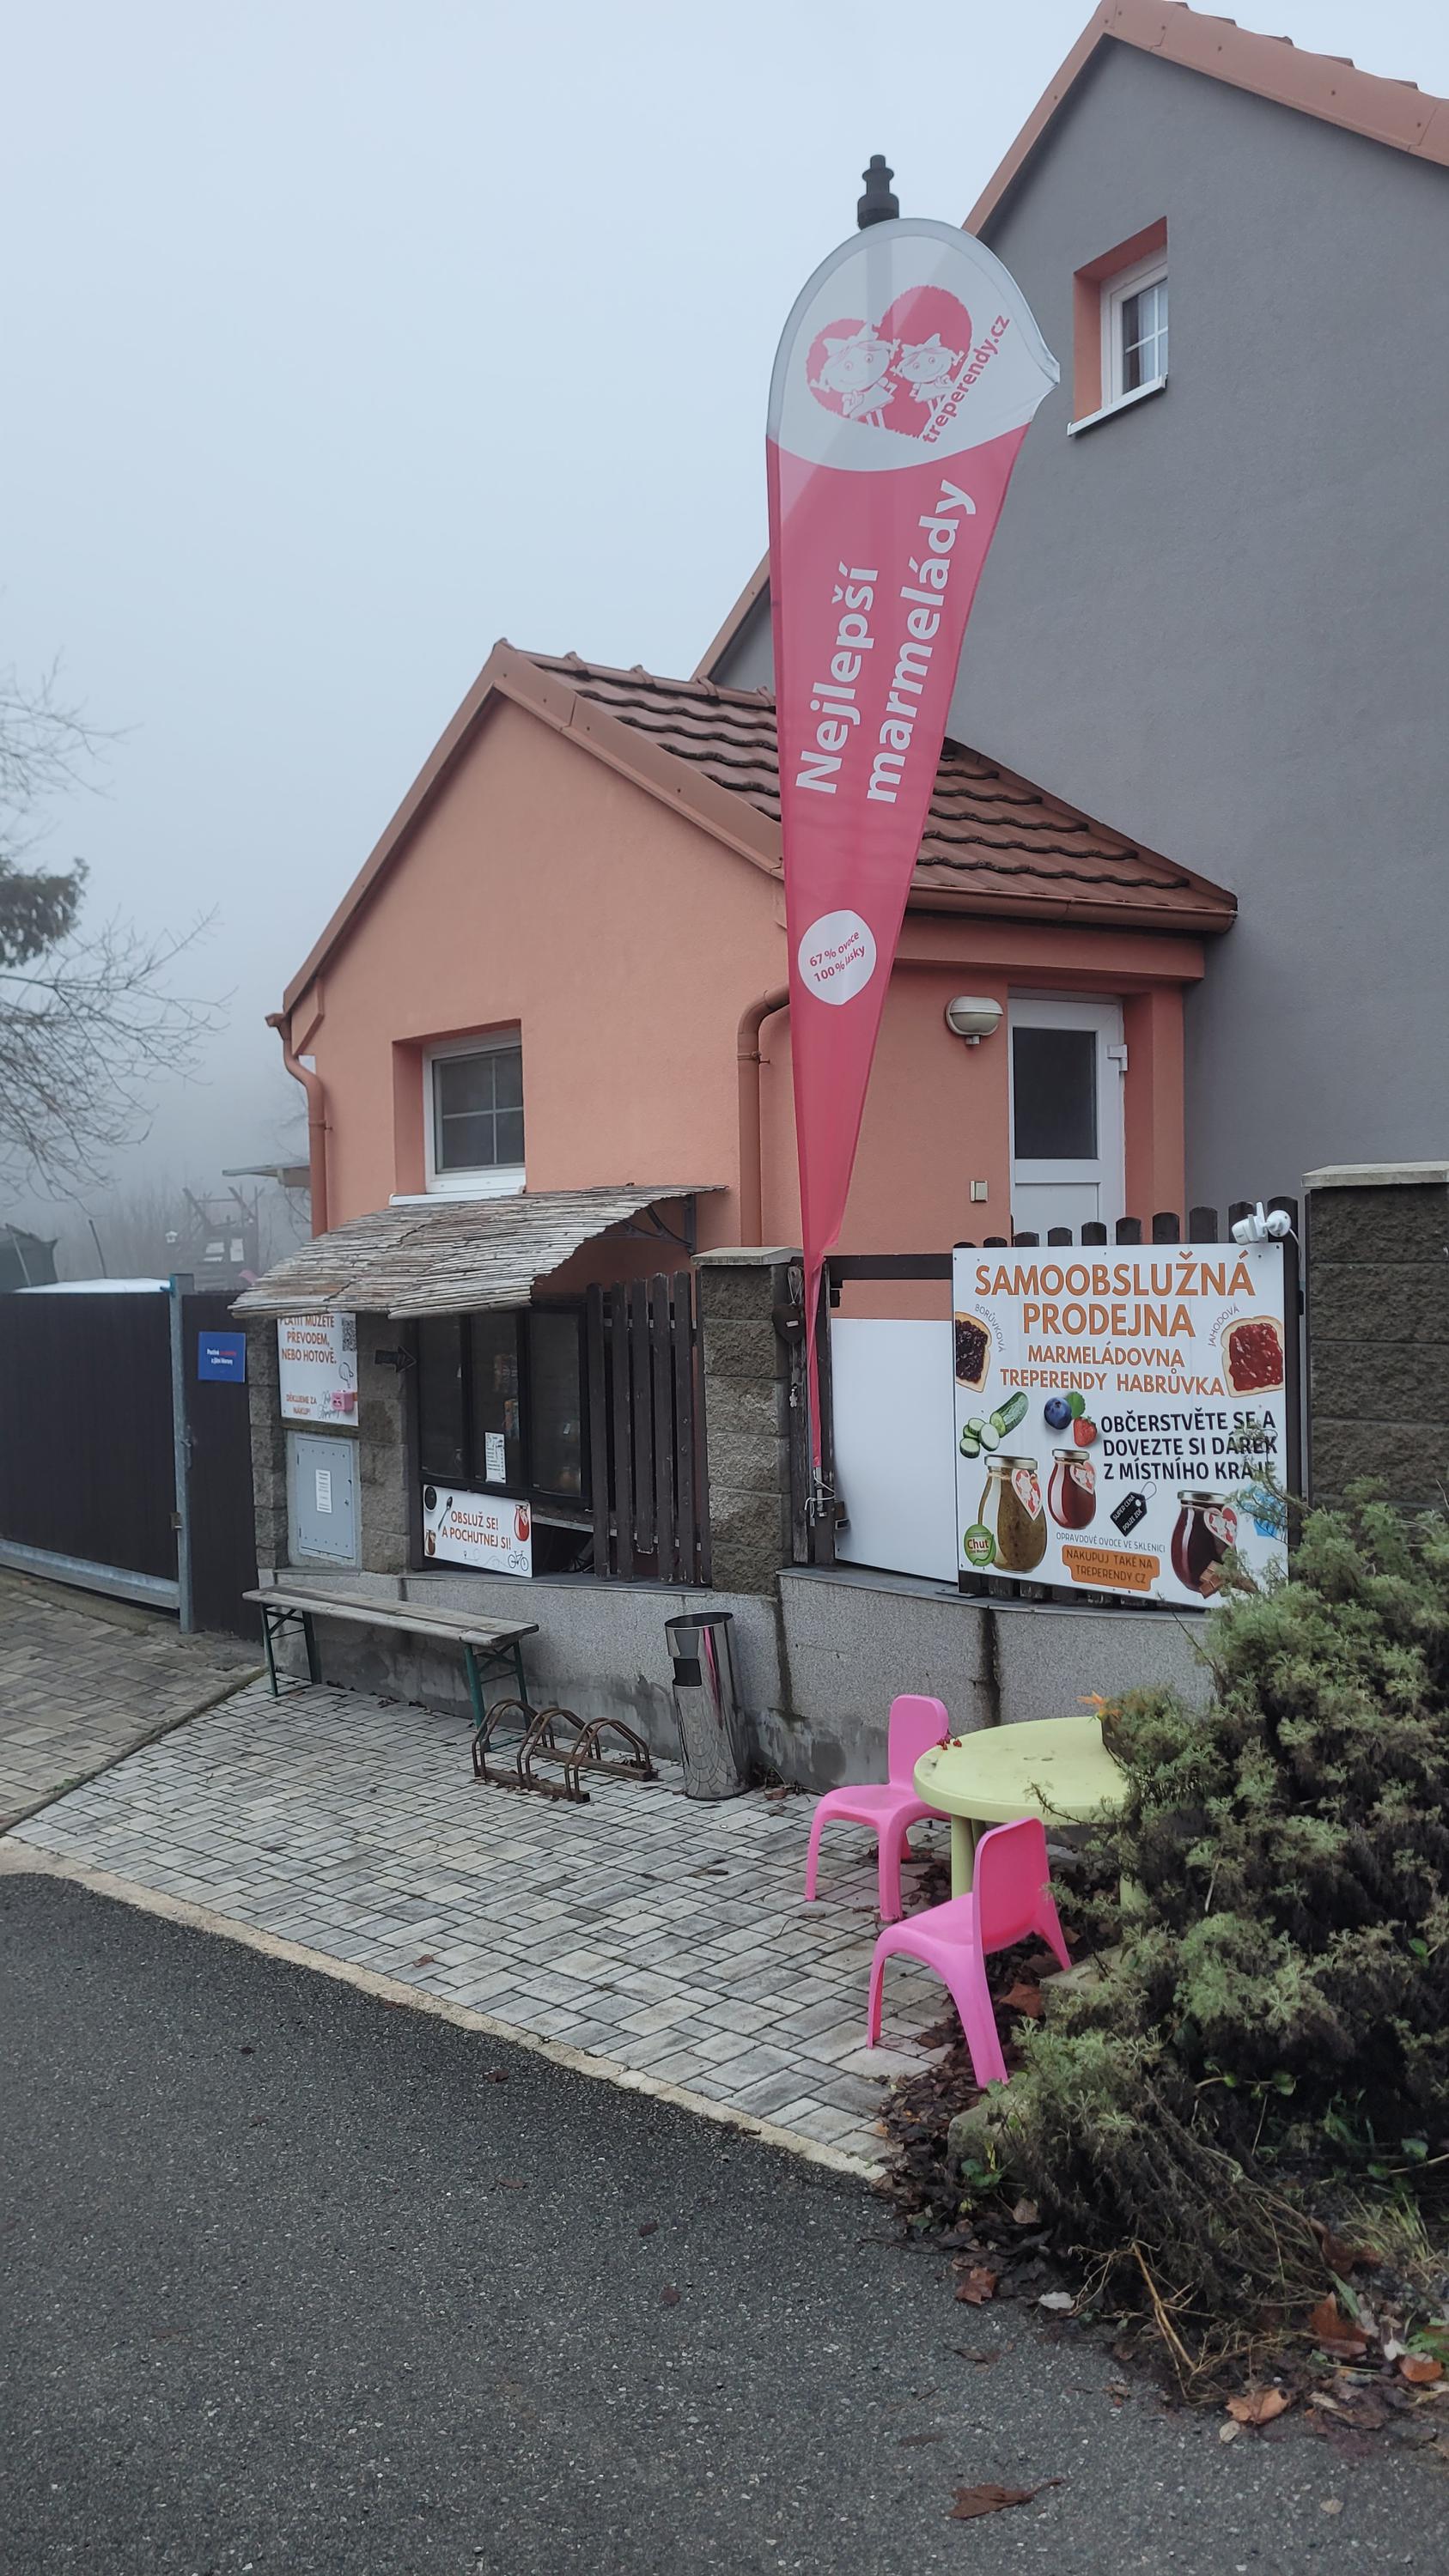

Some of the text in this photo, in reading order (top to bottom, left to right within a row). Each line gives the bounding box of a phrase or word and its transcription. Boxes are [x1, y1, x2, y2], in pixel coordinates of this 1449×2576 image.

[922, 315, 1010, 443] treperendy.cz
[866, 479, 977, 803] marmelády
[795, 561, 879, 794] Nejlepší
[810, 954, 823, 967] 67
[837, 932, 859, 954] ovoce
[974, 1250, 1257, 1297] SAMOOBSLUŽNÁ
[1023, 1302, 1196, 1338] PRODEJNA
[287, 1327, 330, 1346] PŘEVODEM,
[282, 1347, 337, 1364] NEBO HOTOVĚ.
[1027, 1341, 1185, 1368] MARMELÁDOVNA
[1001, 1368, 1226, 1396] TREPERENDY HABRŮVKA
[1101, 1407, 1276, 1433] OBČERSTVĚTE SE A
[1103, 1431, 1278, 1456] DOVEZTE SI DÁREK
[1104, 1463, 1114, 1479] Z
[1119, 1456, 1209, 1480] MÍSTNÍHO
[451, 1510, 498, 1530] OBSLUŽ SE!
[441, 1526, 511, 1550] A POCHUTNEJ SI!
[1056, 1532, 1166, 1552] OPRAVDOVÉ OVOCE VE SKLENICI
[1066, 1549, 1153, 1569] NAKUPUJ TAKÉ NA
[1076, 1564, 1132, 1581] TREPERENDY
